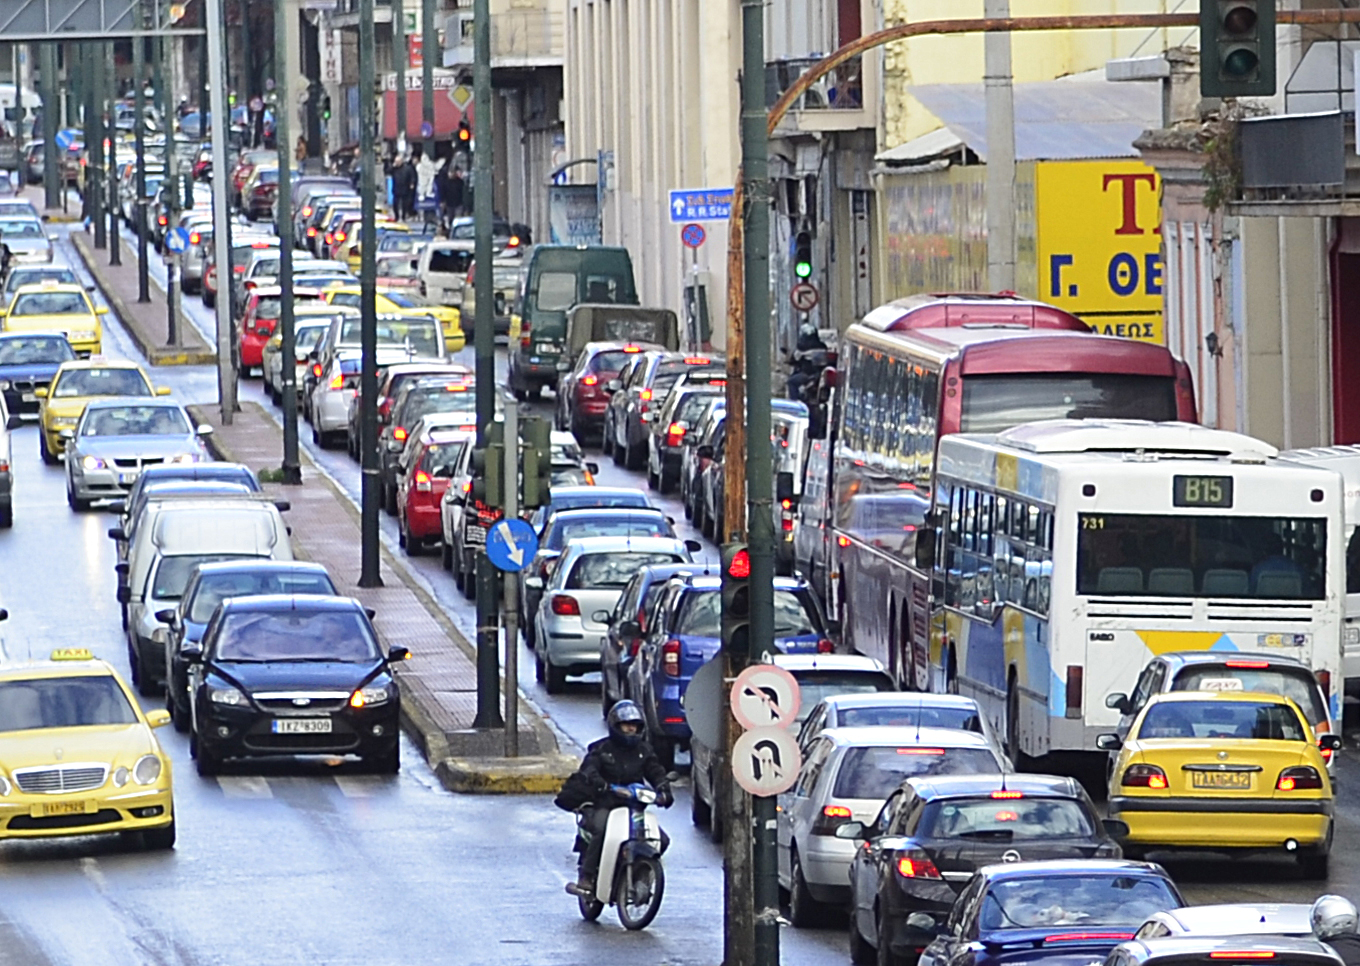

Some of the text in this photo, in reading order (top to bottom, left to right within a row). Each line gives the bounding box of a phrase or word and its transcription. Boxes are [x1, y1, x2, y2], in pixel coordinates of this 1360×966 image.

[1102, 173, 1162, 235] Τ
[1050, 254, 1078, 297] Γ.
[1186, 478, 1222, 502] B15
[1082, 517, 1104, 529] 731
